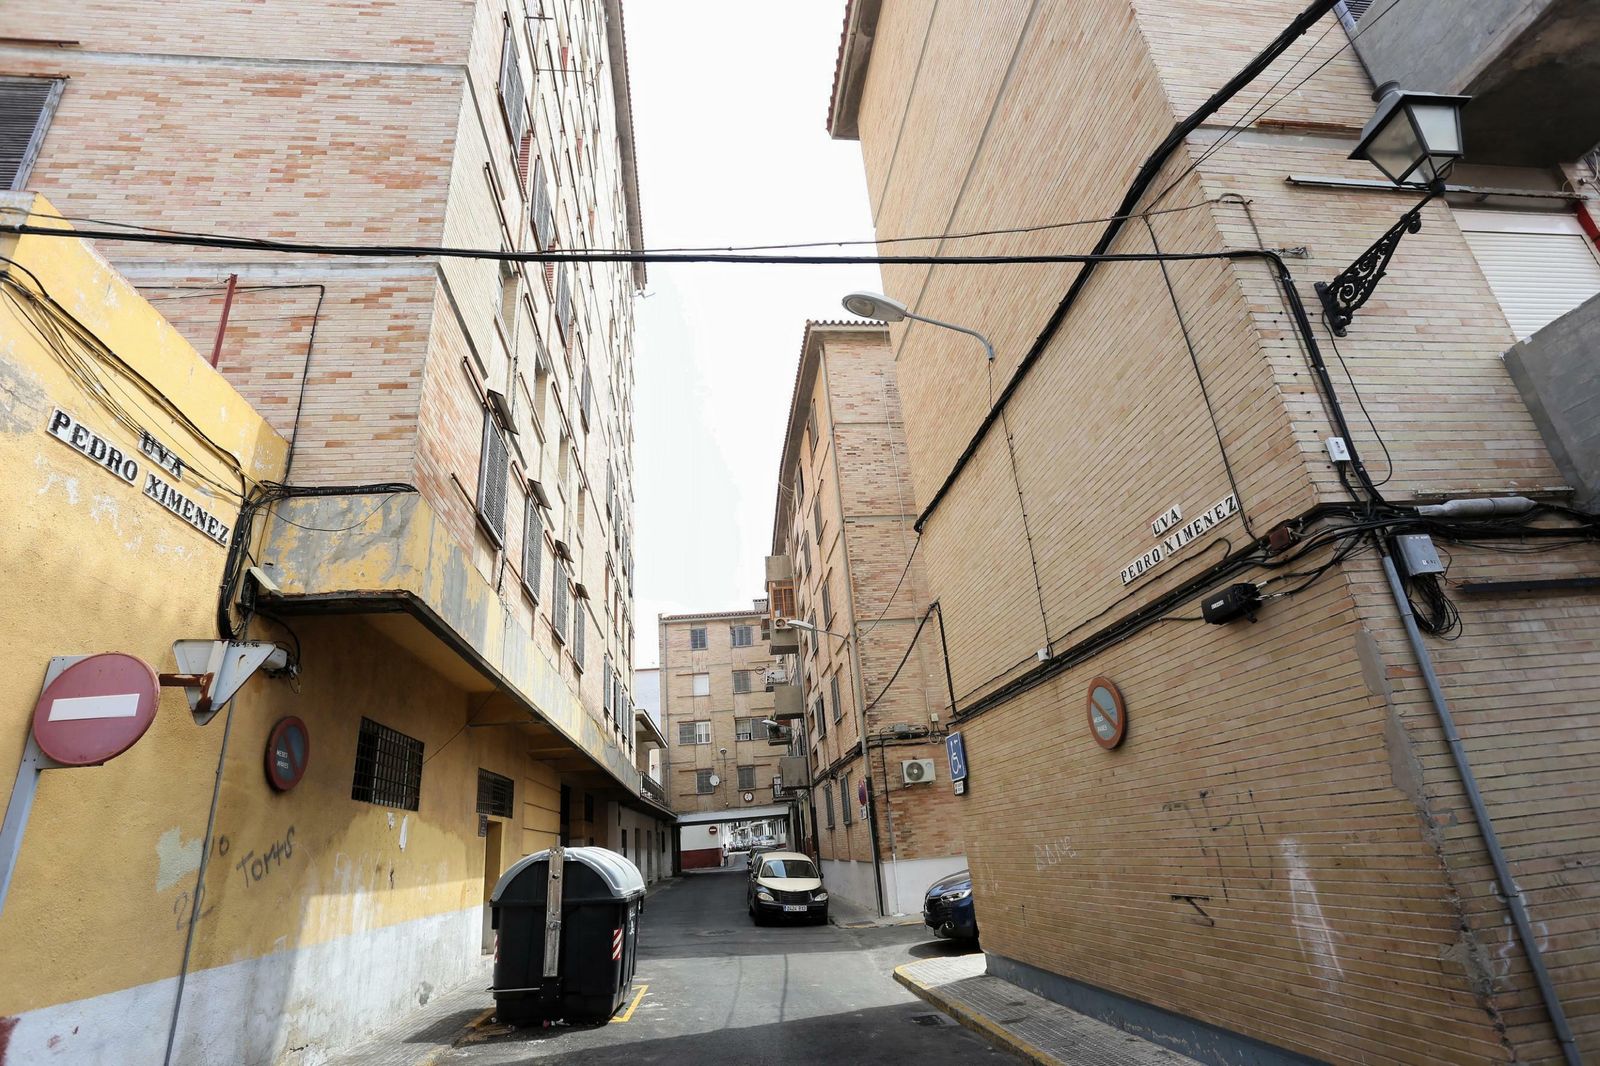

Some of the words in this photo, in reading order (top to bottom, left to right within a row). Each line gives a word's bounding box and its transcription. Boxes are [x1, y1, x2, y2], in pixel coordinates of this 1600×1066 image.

[49, 409, 138, 481] PEDRO
[146, 472, 230, 544] XIMENEZ
[142, 432, 183, 478] UVA
[1120, 548, 1160, 584] PEDRO
[1164, 496, 1238, 555] XIMENEZ
[1152, 508, 1181, 534] UVA
